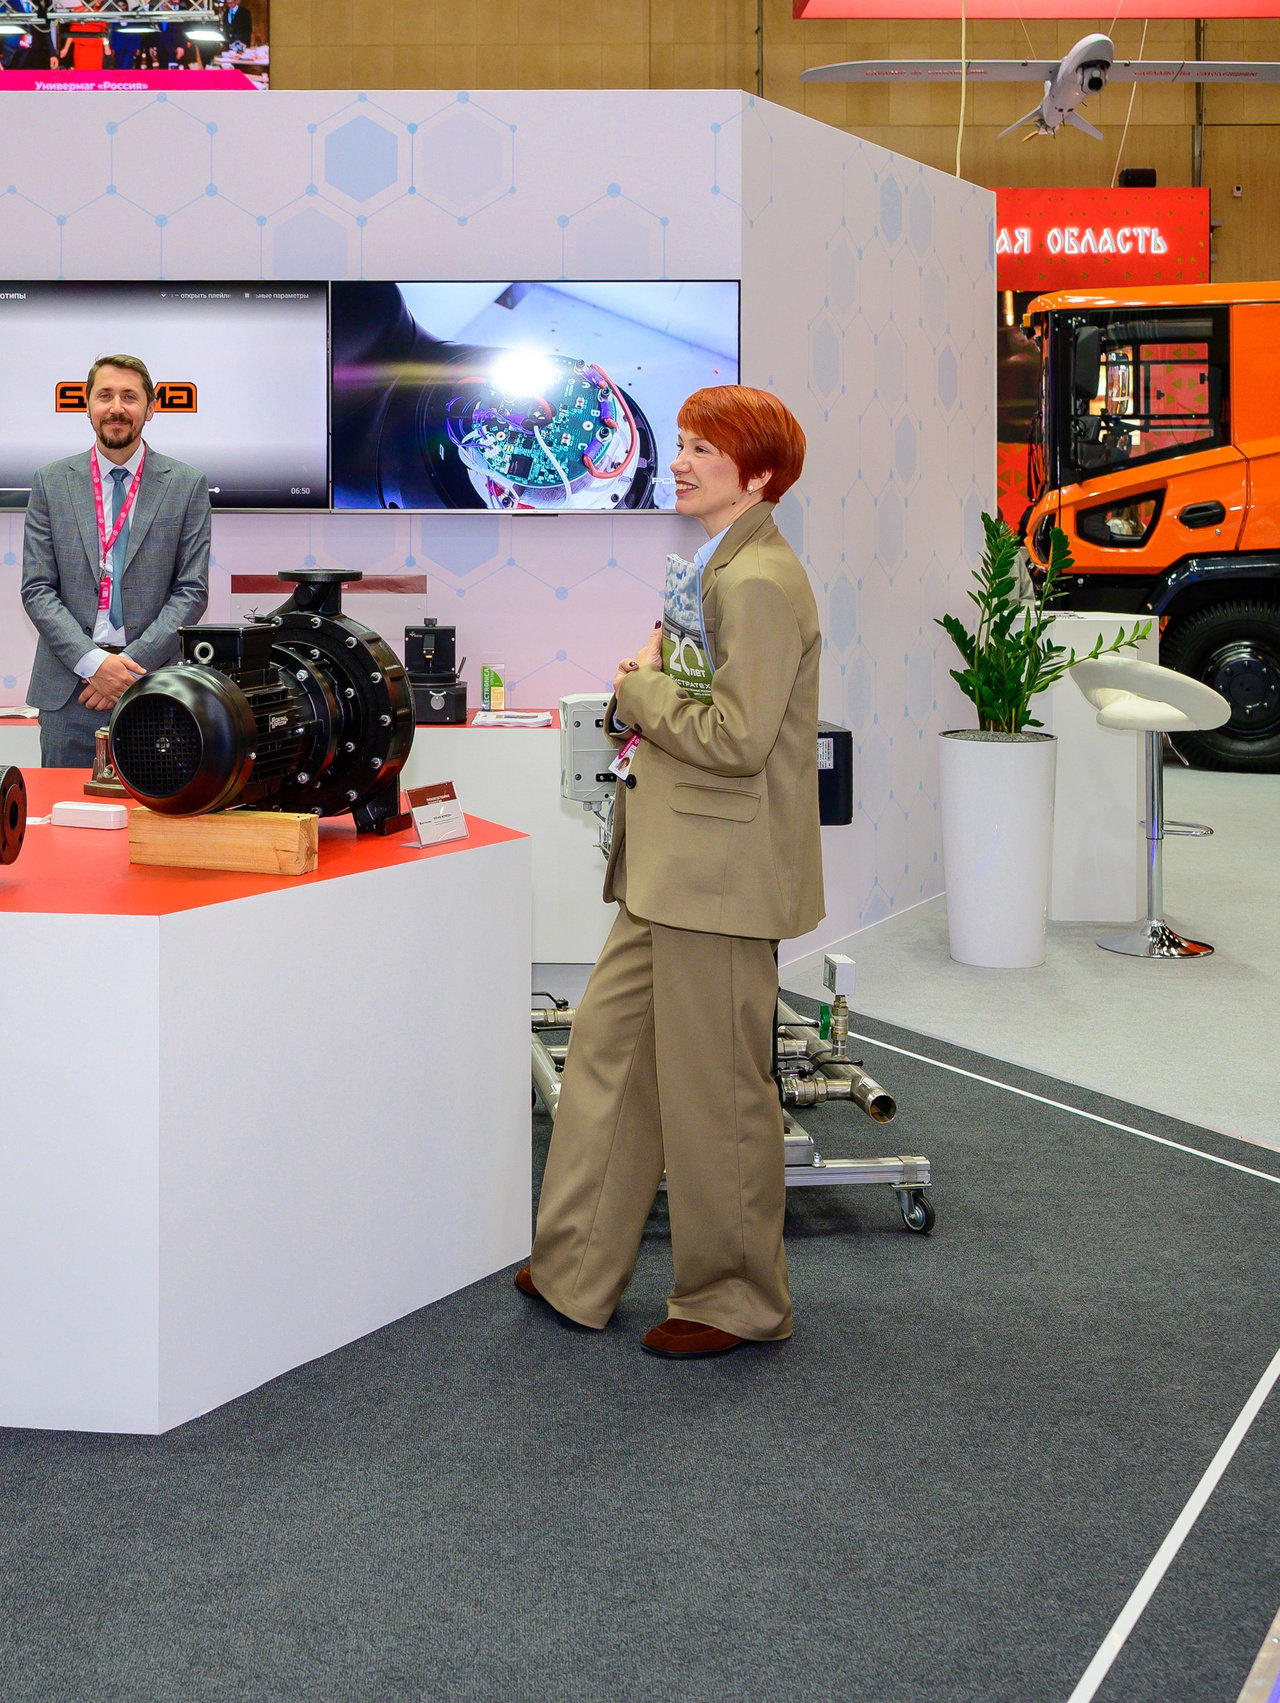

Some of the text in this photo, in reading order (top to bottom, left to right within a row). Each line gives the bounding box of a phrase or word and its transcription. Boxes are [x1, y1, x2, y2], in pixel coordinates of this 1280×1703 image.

[35, 81, 149, 91] Универмаг «Россия»
[1046, 227, 1168, 255] ОБЛАСТЬ
[180, 292, 208, 300] открыть
[290, 487, 310, 496] 06:50
[669, 632, 705, 676] 20
